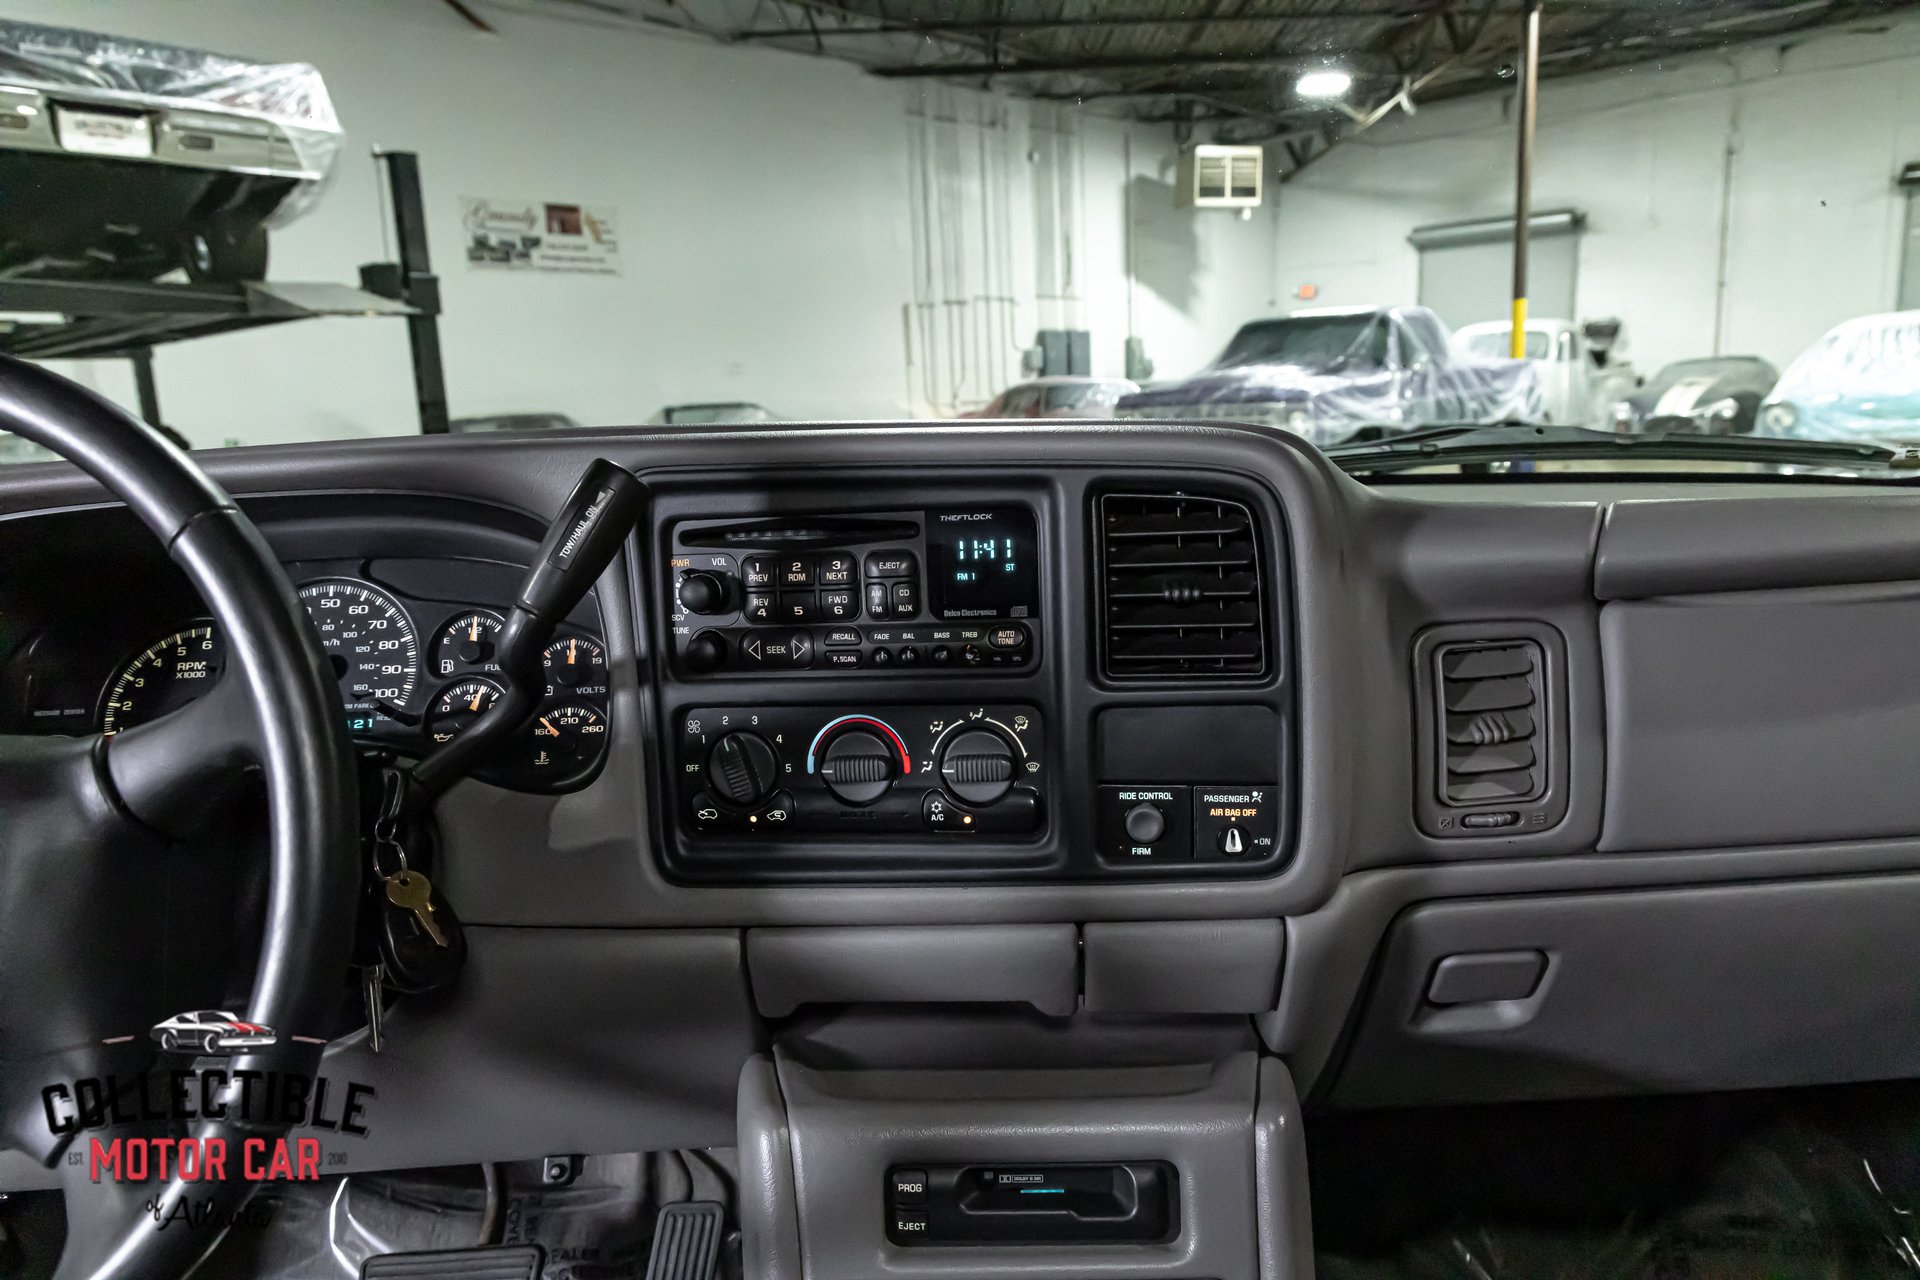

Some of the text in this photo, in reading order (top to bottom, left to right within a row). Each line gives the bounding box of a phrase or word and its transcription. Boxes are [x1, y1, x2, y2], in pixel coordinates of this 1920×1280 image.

[940, 513, 993, 521] THEFTLOCK
[559, 504, 598, 558] TOW/HAUL ON
[959, 539, 1011, 559] 11:41
[711, 558, 728, 566] VOL
[832, 561, 841, 570] 3
[879, 562, 900, 570] EJECT
[755, 563, 760, 572] 1
[792, 562, 802, 571] 2
[1005, 563, 1015, 571] ST
[748, 574, 769, 582] PREV
[788, 573, 806, 581] RDM
[826, 572, 848, 580] NEXT
[957, 572, 976, 581] FM 1
[899, 589, 910, 597] CD
[320, 598, 341, 608] 50
[828, 596, 848, 604] FWD
[348, 605, 369, 615] 60
[757, 608, 767, 617] 4
[794, 607, 803, 616] 5
[833, 606, 843, 615] 6
[671, 614, 685, 622] SCV
[367, 619, 388, 630] 70
[468, 626, 482, 634] 12
[378, 640, 399, 650] 80
[443, 637, 450, 645] E
[997, 637, 1015, 645] TONE
[202, 641, 213, 650] 6
[355, 645, 371, 653] 120
[766, 645, 786, 653] SEEK
[177, 647, 187, 657] 5
[153, 659, 162, 668] 4
[543, 659, 552, 667] 9
[591, 657, 602, 665] 19
[381, 665, 402, 675] 90
[176, 671, 206, 679] X1000
[134, 678, 144, 688] 3
[374, 688, 399, 698] 100
[576, 686, 606, 694] VOLTS
[122, 701, 132, 711] 2
[442, 705, 450, 713] 0
[347, 718, 373, 729] 21
[560, 717, 578, 725] 210
[723, 716, 729, 725] 2
[752, 716, 758, 725] 3
[534, 728, 552, 736] 160
[582, 725, 604, 734] 260
[702, 735, 706, 743] 1
[776, 735, 783, 743] 4
[686, 764, 700, 772] OFF
[785, 764, 792, 773] 5
[1119, 792, 1173, 800] RIDE CONTROL
[1204, 795, 1250, 803] PASSENGER
[1210, 808, 1257, 817] AIR BAG OFF
[931, 813, 944, 821] A/C
[1259, 837, 1271, 846] ON
[1131, 847, 1151, 855] FIRM
[898, 1183, 923, 1193] PROG
[898, 1221, 926, 1232] EJECT
